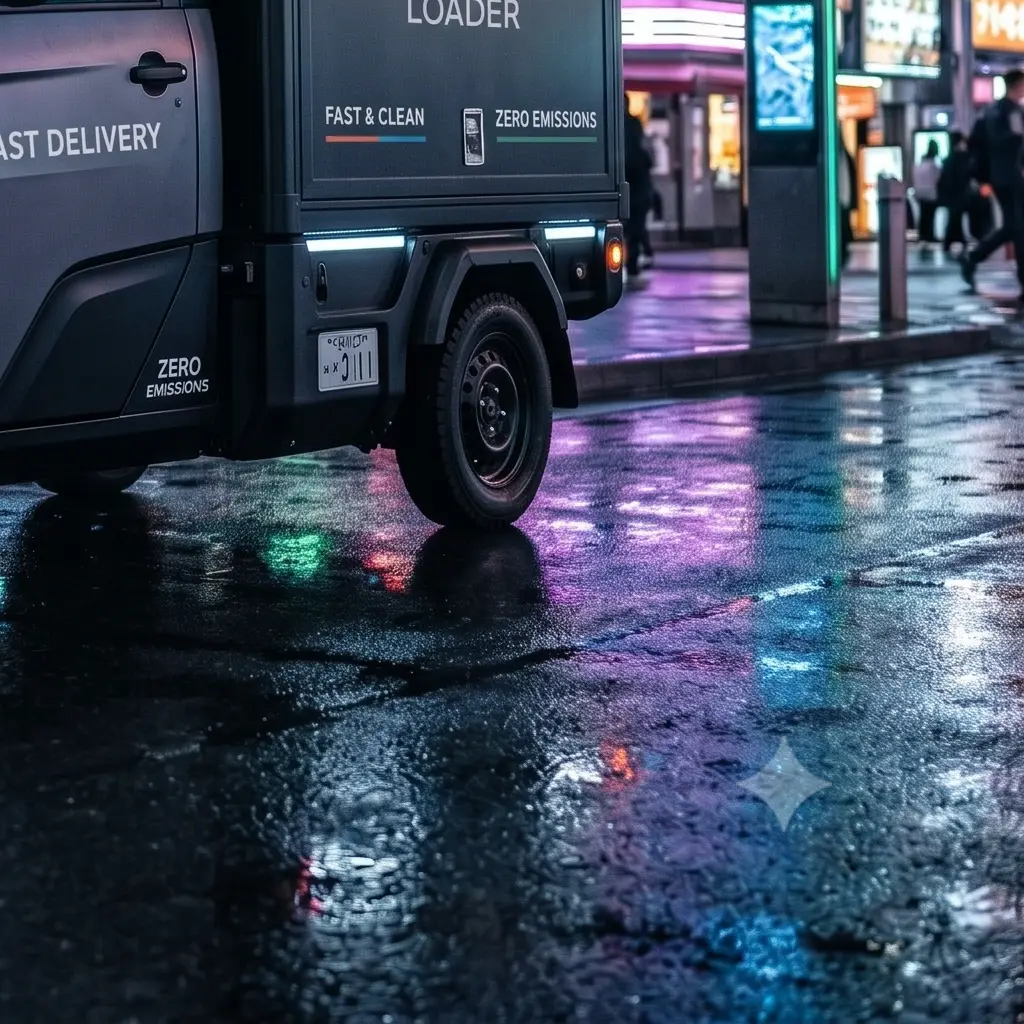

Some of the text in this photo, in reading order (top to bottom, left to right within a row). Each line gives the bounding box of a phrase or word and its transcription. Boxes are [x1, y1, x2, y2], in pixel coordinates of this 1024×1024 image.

[325, 106, 425, 126] FAST & CLEAN
[495, 109, 597, 129] ZERO EMISSIONS
[46, 122, 161, 157] DELIVERY
[157, 356, 201, 379] ZERO
[146, 379, 209, 398] EMISSIONS
